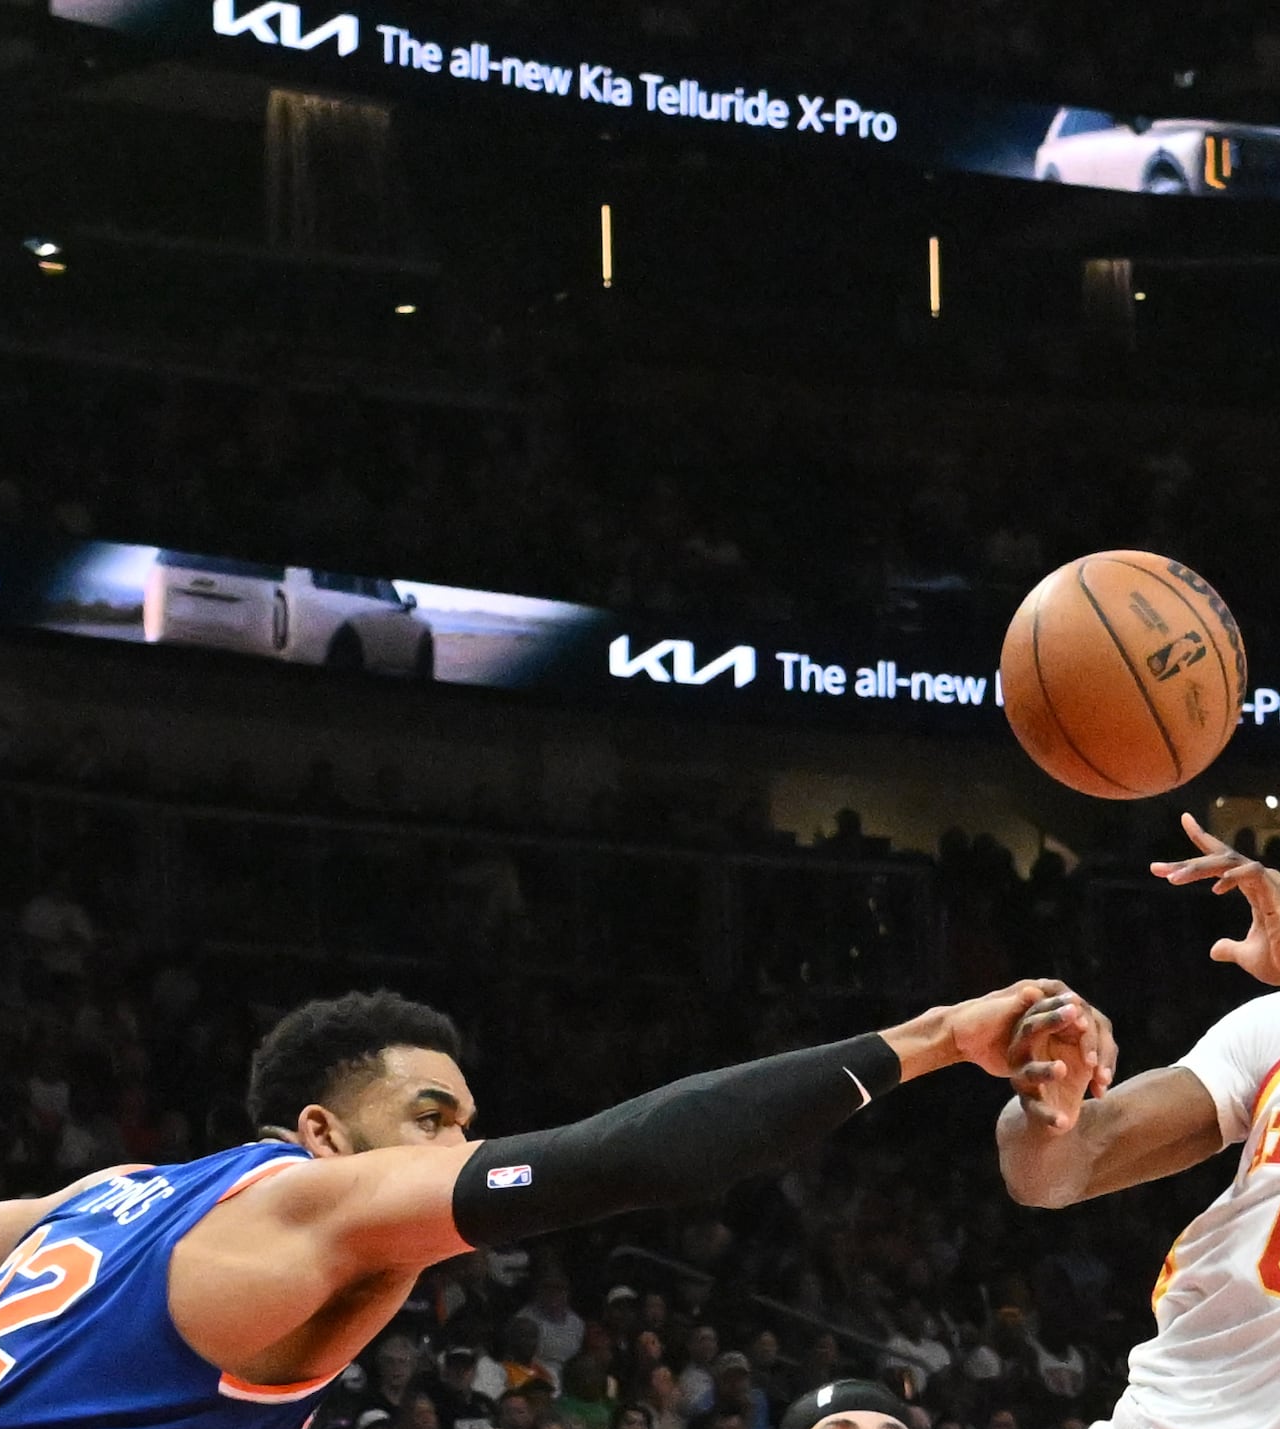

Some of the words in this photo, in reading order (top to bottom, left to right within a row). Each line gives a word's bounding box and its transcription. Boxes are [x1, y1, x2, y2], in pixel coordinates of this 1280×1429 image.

[376, 24, 443, 73] The
[449, 42, 573, 96] all-new
[579, 62, 633, 107] Kia
[638, 73, 790, 130] Telluride
[796, 94, 898, 142] X-Pro
[608, 634, 756, 688] KIA
[775, 652, 847, 696] The
[854, 660, 987, 706] all-new
